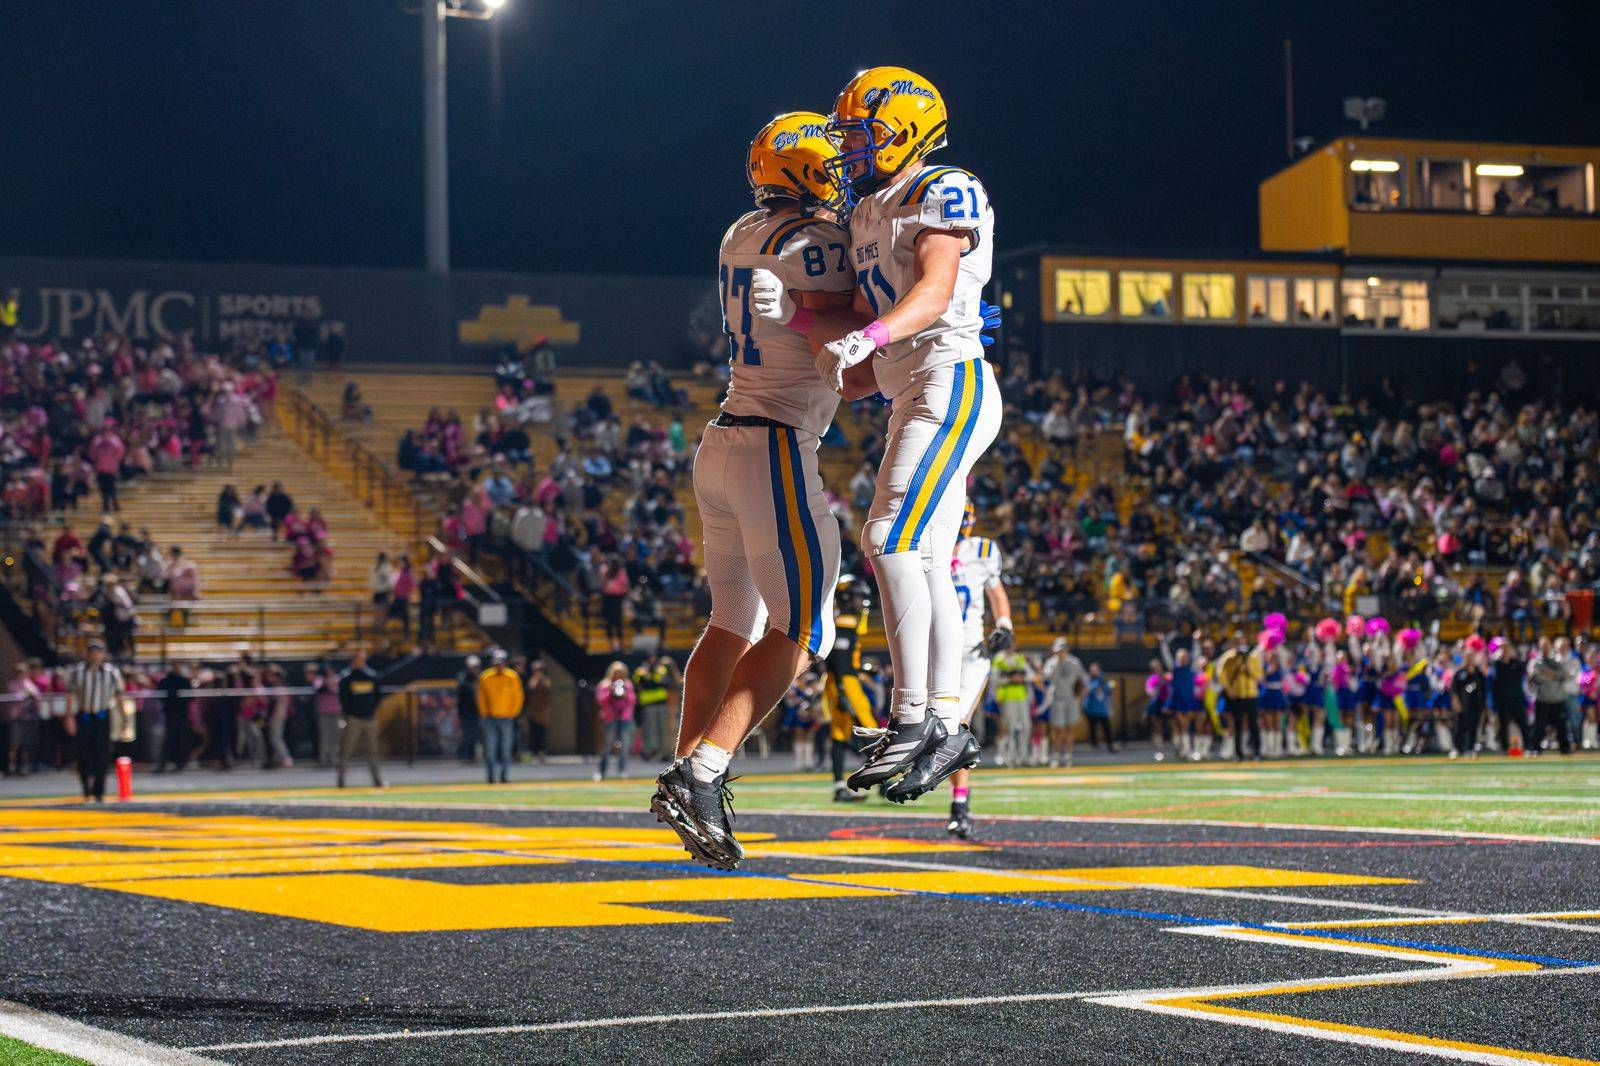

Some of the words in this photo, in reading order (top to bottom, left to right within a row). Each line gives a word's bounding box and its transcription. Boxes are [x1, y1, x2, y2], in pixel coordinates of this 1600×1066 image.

[890, 80, 935, 100] Macs
[771, 131, 800, 151] Big
[942, 186, 980, 220] 21
[802, 242, 847, 278] 87
[9, 286, 197, 339] UPMC
[219, 294, 322, 318] SPORTS
